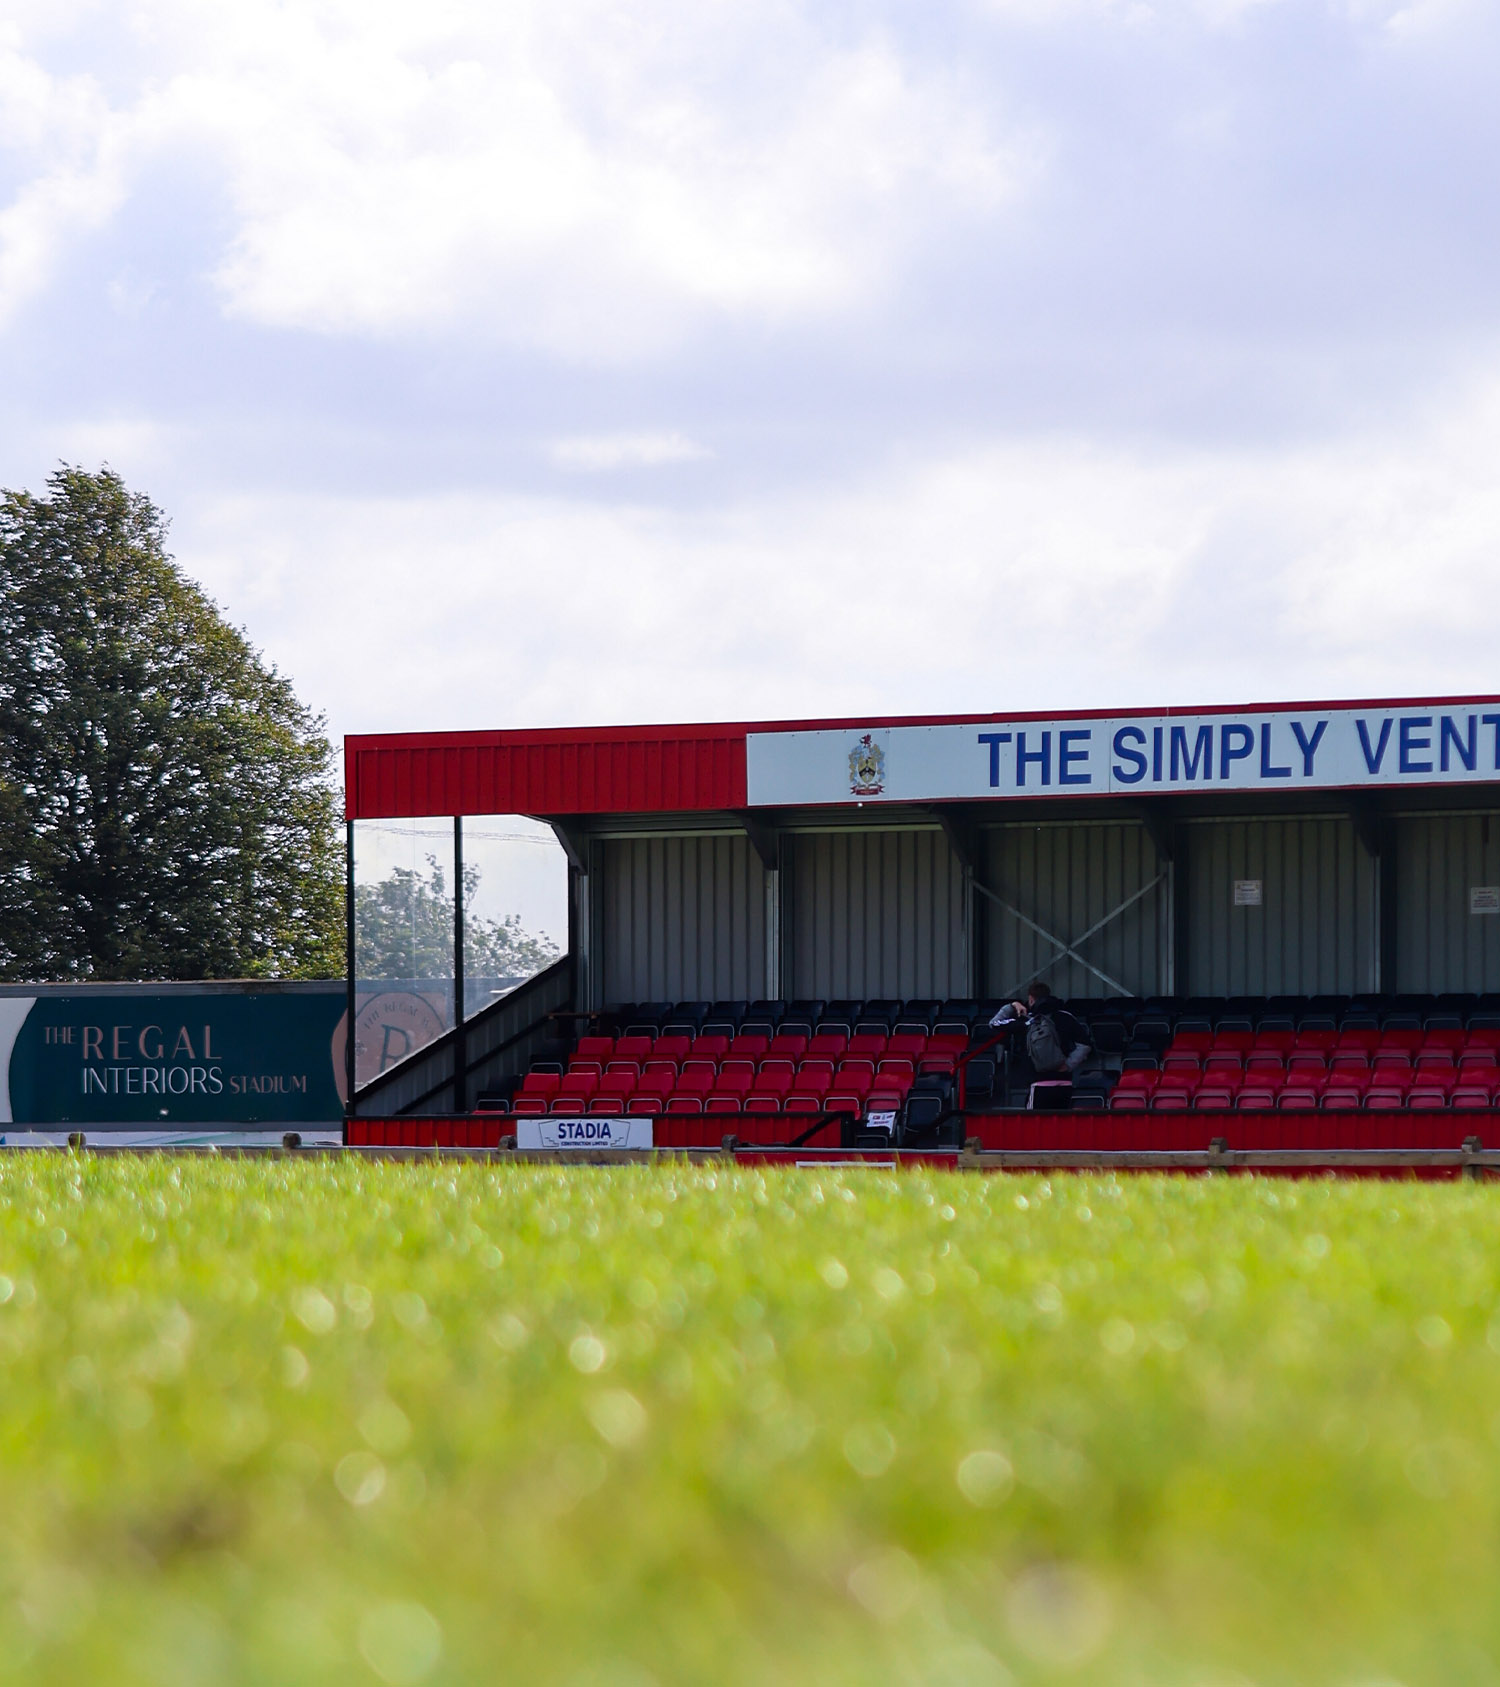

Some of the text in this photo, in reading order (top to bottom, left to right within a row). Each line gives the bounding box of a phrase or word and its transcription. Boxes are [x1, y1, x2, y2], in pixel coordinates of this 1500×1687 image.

[978, 728, 1092, 787] THE
[1112, 720, 1329, 785] SIMPLY
[44, 1024, 223, 1060] THE REGAL
[82, 1066, 307, 1094] INTERIORS STADIUM
[558, 1122, 612, 1140] STADIA
